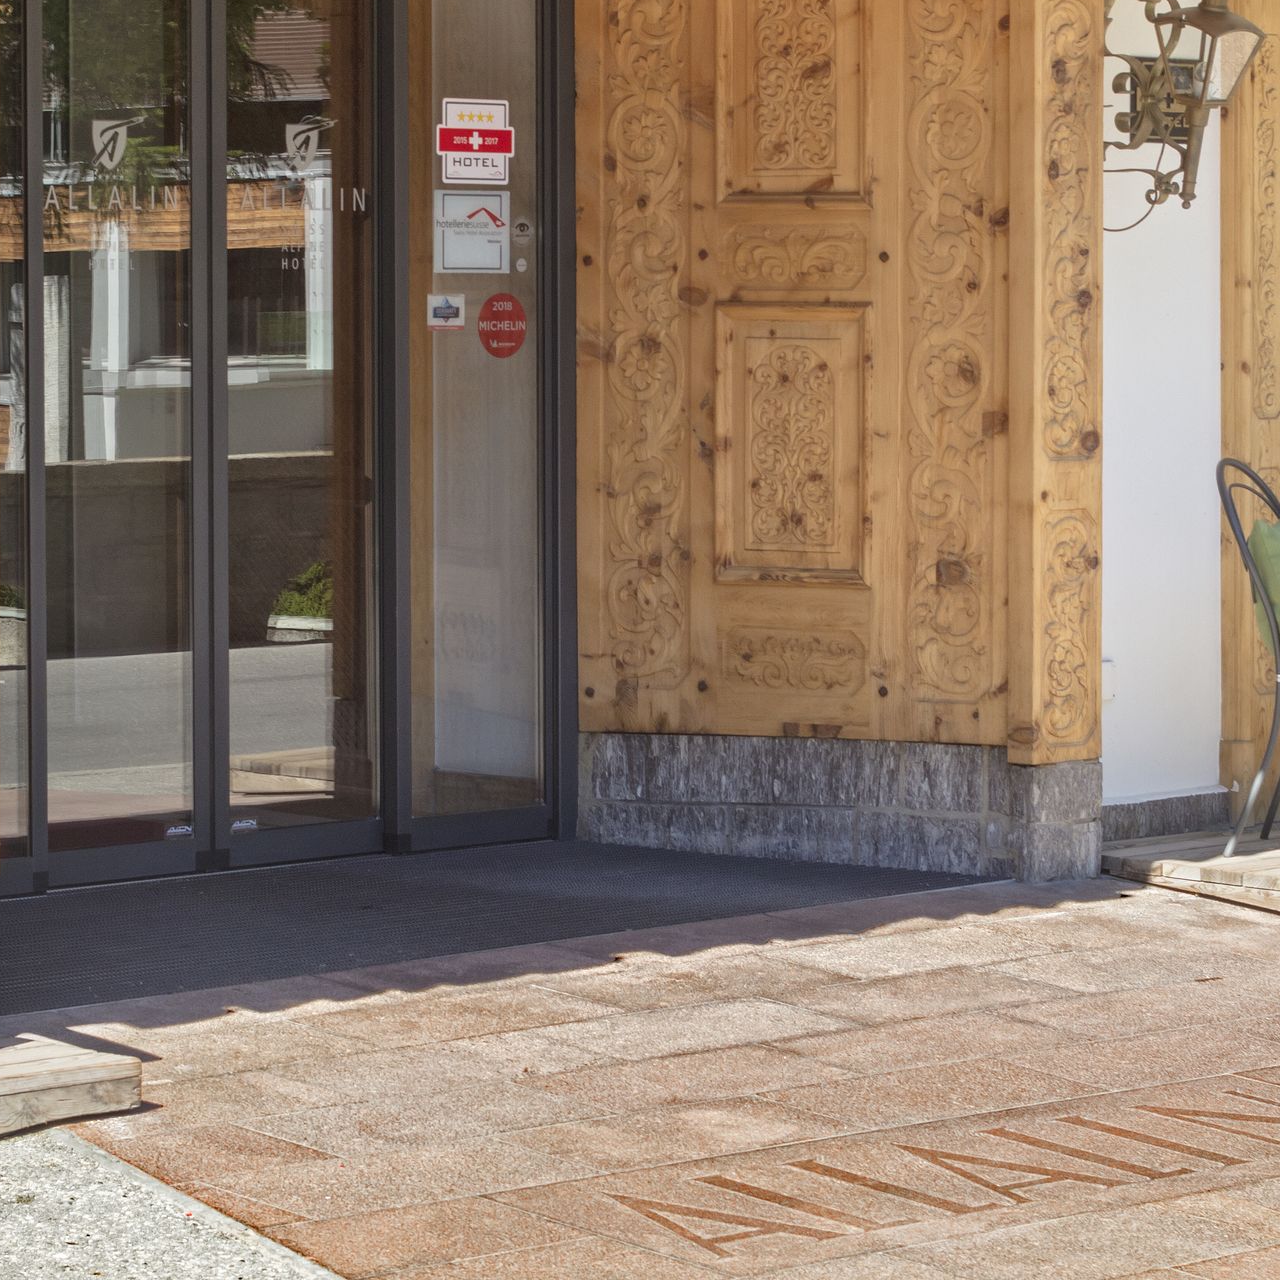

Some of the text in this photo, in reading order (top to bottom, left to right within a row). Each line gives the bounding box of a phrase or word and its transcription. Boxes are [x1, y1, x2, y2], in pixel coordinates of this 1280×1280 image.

[453, 136, 499, 145] 2015 2017
[452, 157, 499, 168] HOTEL
[43, 185, 178, 211] ALLALIN
[240, 186, 366, 212] ALLALIN
[492, 301, 513, 311] 2018
[479, 320, 526, 331] MICHELIN
